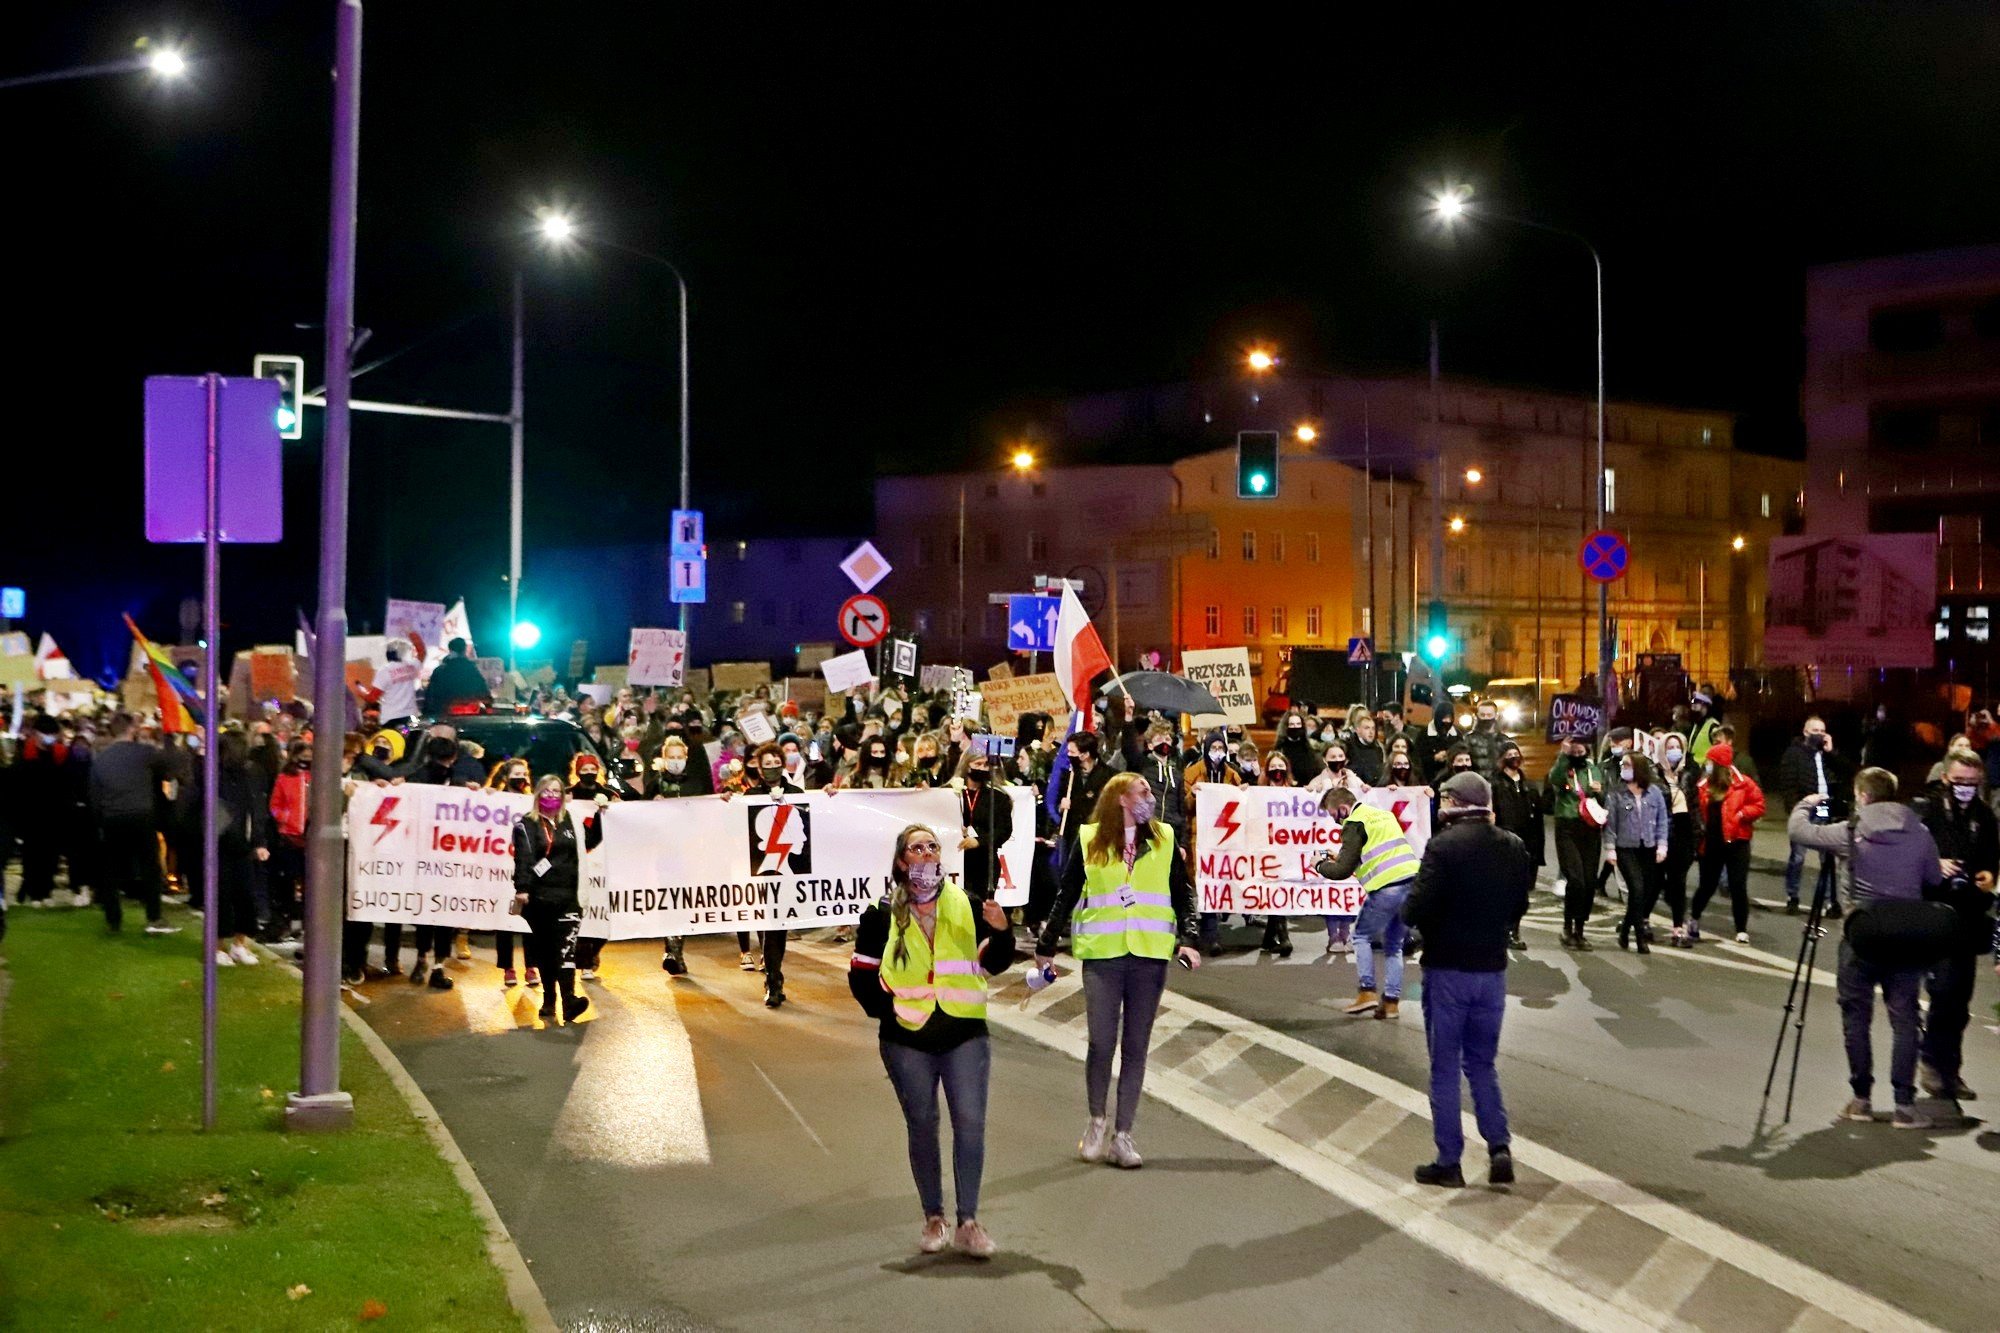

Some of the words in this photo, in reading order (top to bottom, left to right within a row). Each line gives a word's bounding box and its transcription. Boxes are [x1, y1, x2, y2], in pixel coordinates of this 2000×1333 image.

[1187, 662, 1246, 680] PRZYSZŁA
[359, 861, 405, 876] KIEDY
[1200, 854, 1282, 881] MACIE
[352, 892, 423, 916] SWOJEJ
[430, 894, 499, 914] SIOSTRY
[608, 881, 782, 915] MIĘDZYNARODOWY
[796, 876, 872, 904] STRAJK
[1203, 884, 1233, 911] NA
[1242, 885, 1324, 910] SWOICH
[690, 907, 799, 924] JELENIA
[816, 901, 860, 917] GÓR
